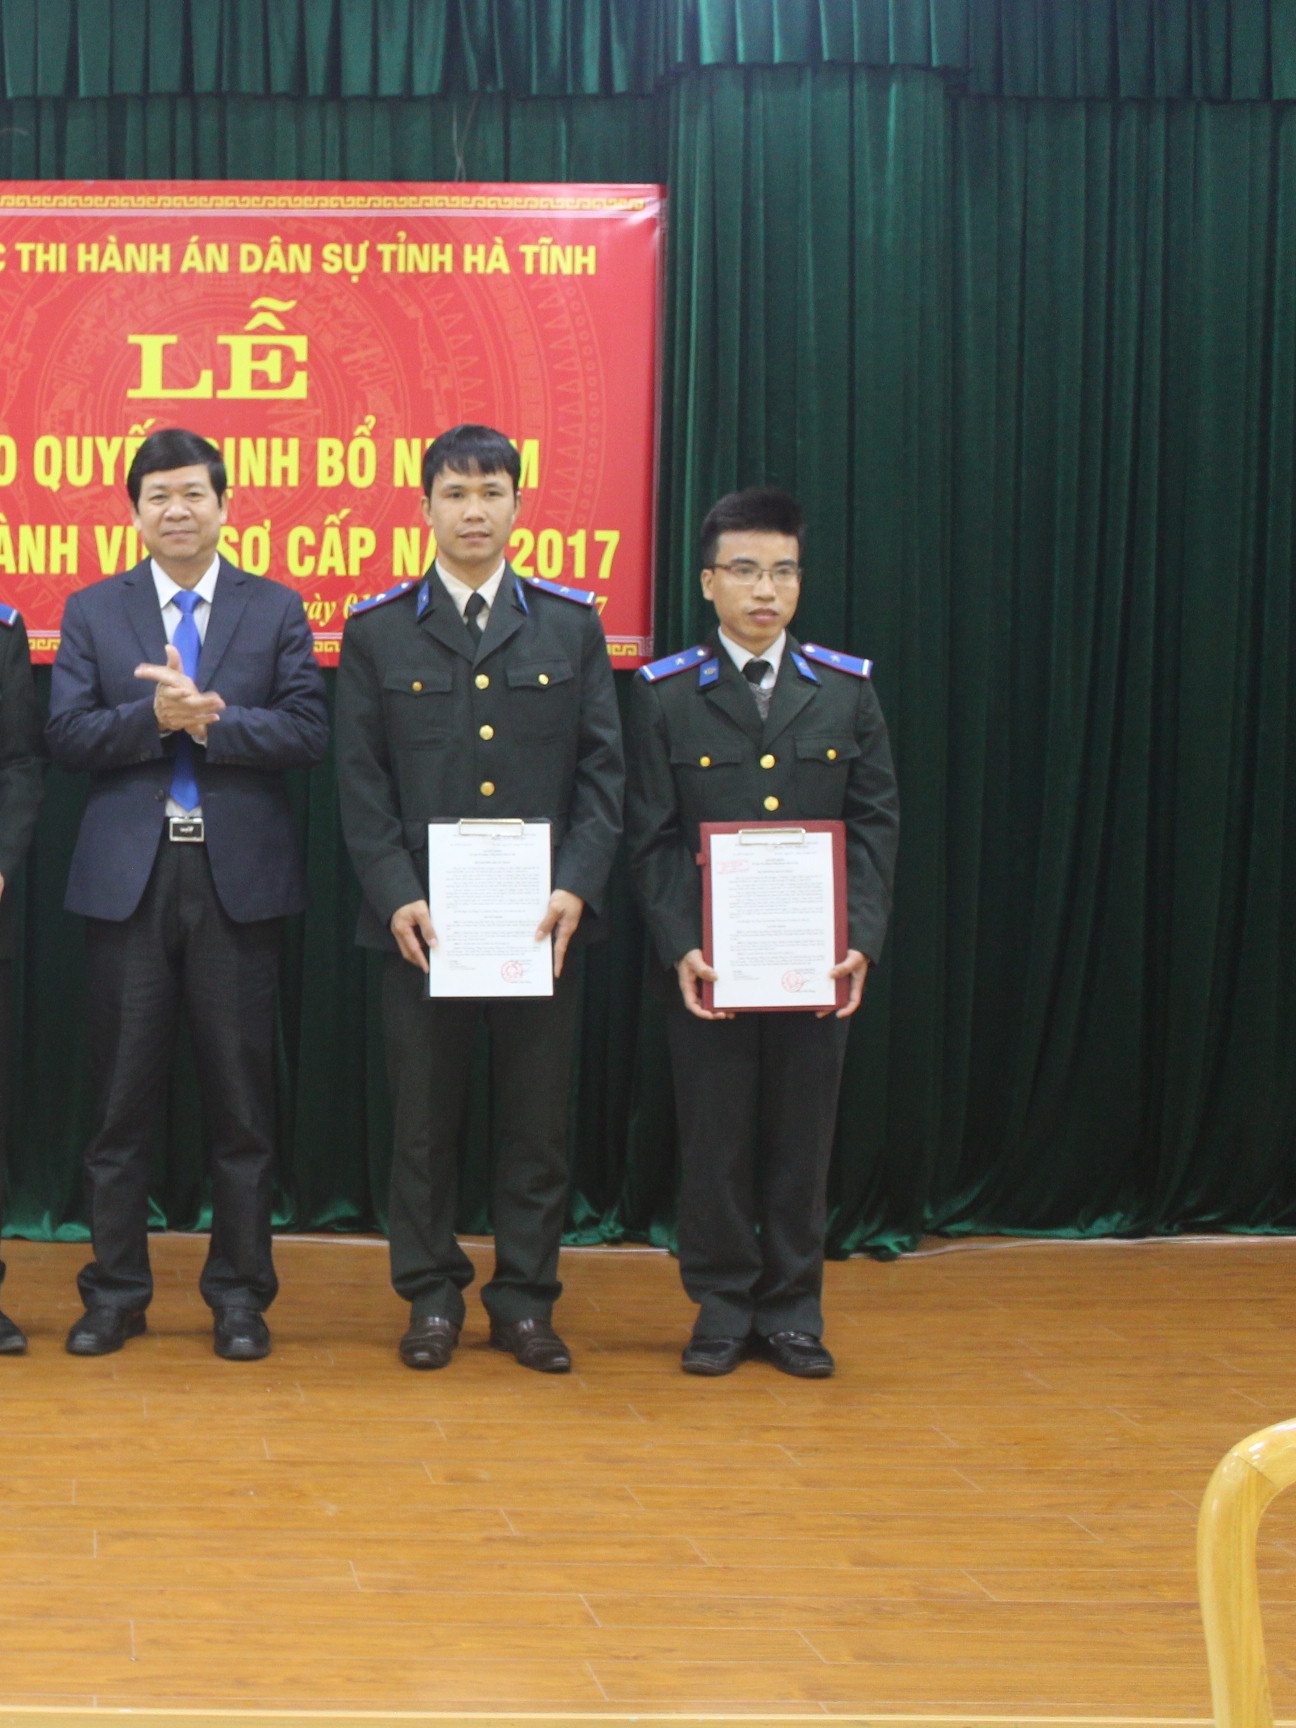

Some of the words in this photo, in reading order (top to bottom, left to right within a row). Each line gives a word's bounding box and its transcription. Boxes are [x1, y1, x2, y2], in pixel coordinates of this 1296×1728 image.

[15, 243, 67, 273] THI
[77, 236, 171, 274] HÀNH
[181, 236, 229, 273] ÁN
[240, 236, 312, 273] DÂN
[321, 241, 370, 283] SỰ
[377, 231, 453, 274] TỈNH
[463, 237, 510, 274] HÀ
[519, 238, 596, 275] TĨNH
[127, 297, 308, 399] LỄ
[205, 437, 299, 499] ỊNH
[317, 414, 377, 489] BỔ
[216, 519, 271, 577] SƠ
[287, 509, 376, 577] CẤP
[508, 529, 620, 579] 2017
